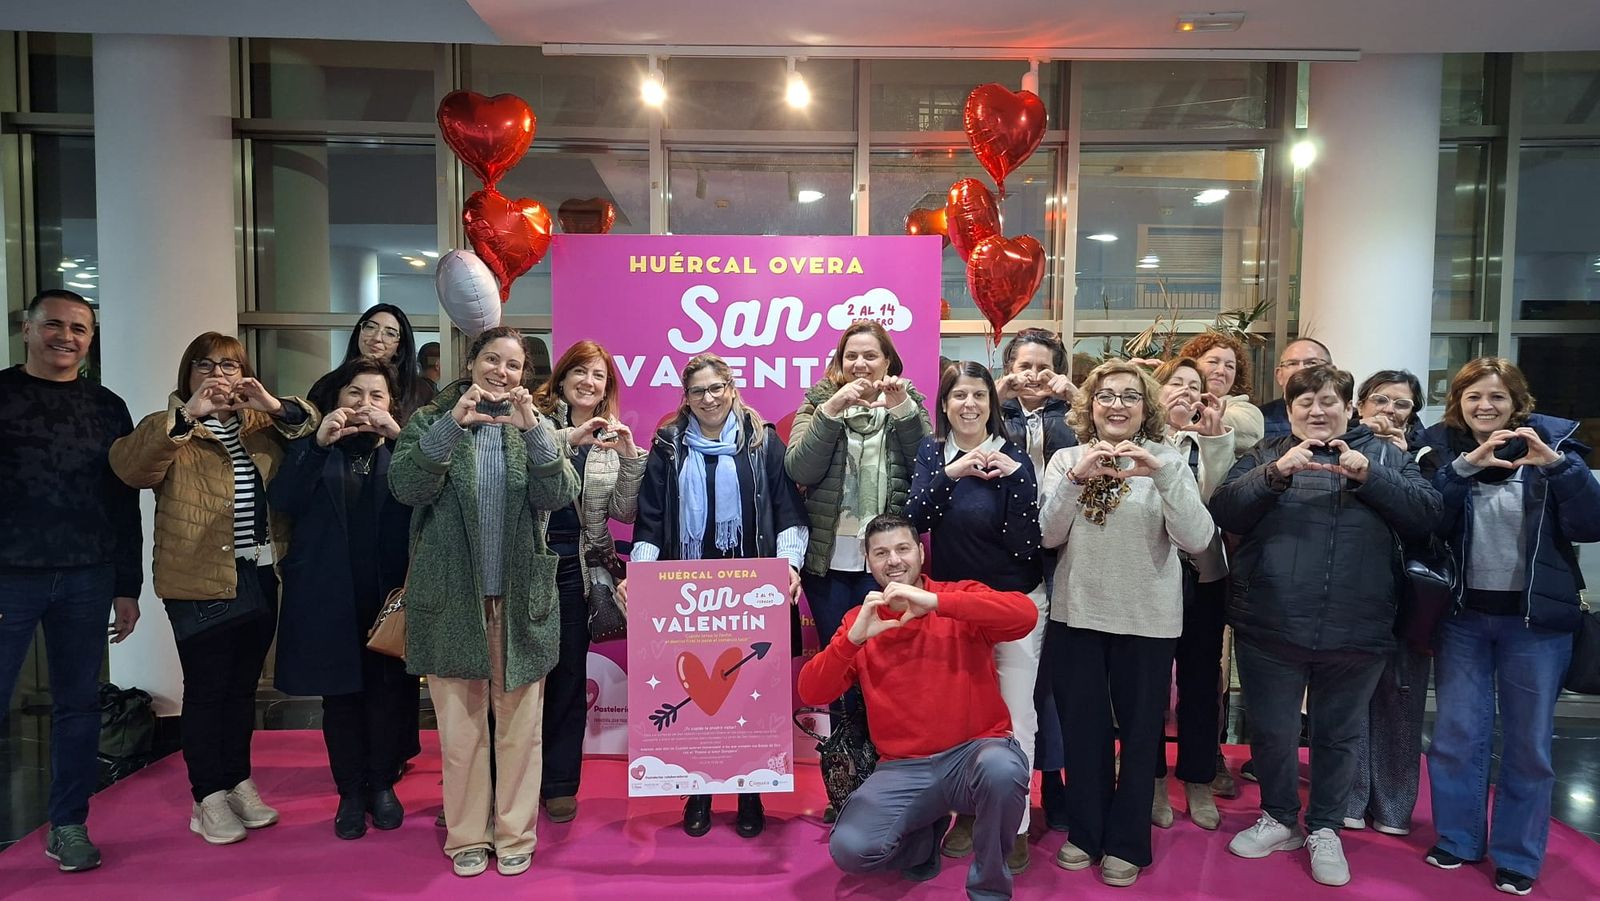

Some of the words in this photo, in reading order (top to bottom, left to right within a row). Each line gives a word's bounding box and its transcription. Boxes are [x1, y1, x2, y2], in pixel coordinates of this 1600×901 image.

[629, 252, 757, 274] HUÉRCAL
[769, 256, 864, 274] OVERA
[667, 285, 822, 354] San
[847, 303, 855, 316] 2
[860, 305, 875, 316] AL
[880, 303, 896, 316] 14
[659, 569, 713, 580] HUÉRCAL
[717, 569, 758, 579] OVERA
[675, 582, 741, 616] San
[652, 610, 766, 633] VALENTÍN
